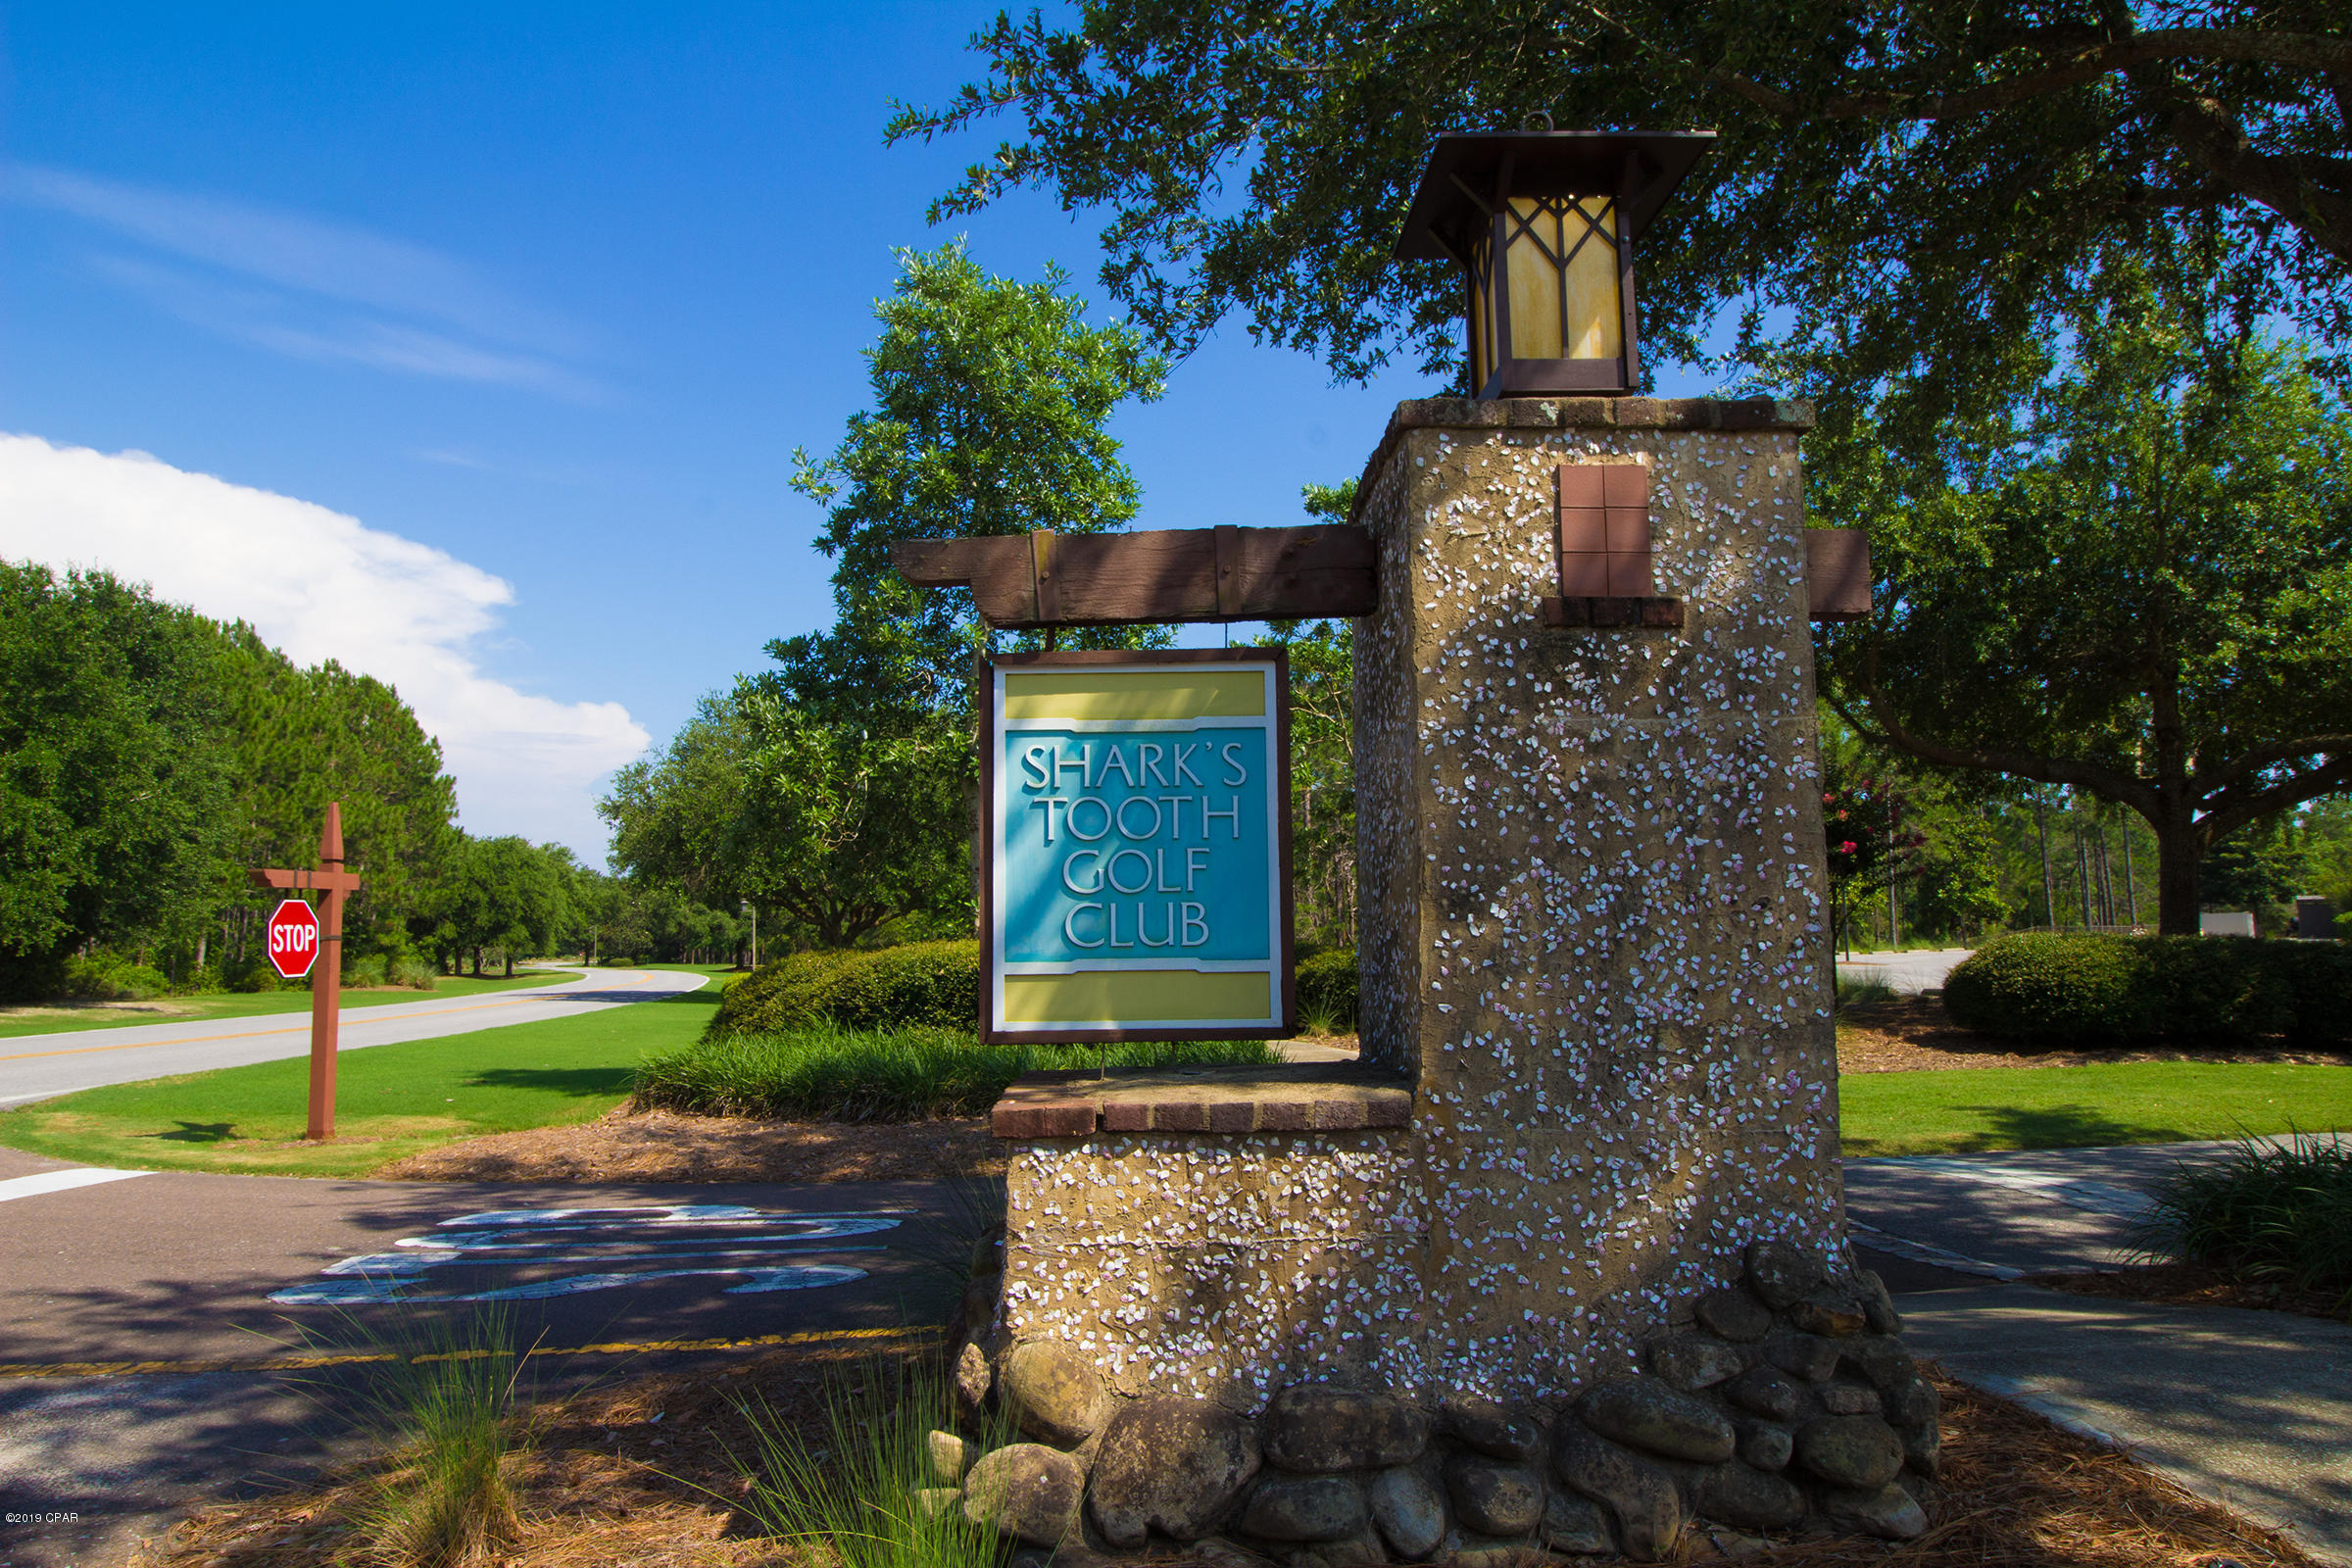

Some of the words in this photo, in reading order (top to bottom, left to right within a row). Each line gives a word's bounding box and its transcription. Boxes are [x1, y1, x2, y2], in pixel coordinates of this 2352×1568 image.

[1025, 742, 1247, 788] SHARK'S
[1034, 795, 1239, 841] TOOTH
[1063, 848, 1210, 894] GOLF
[272, 924, 316, 953] STOP
[1065, 902, 1209, 948] CLUB
[266, 1203, 919, 1305] STOP
